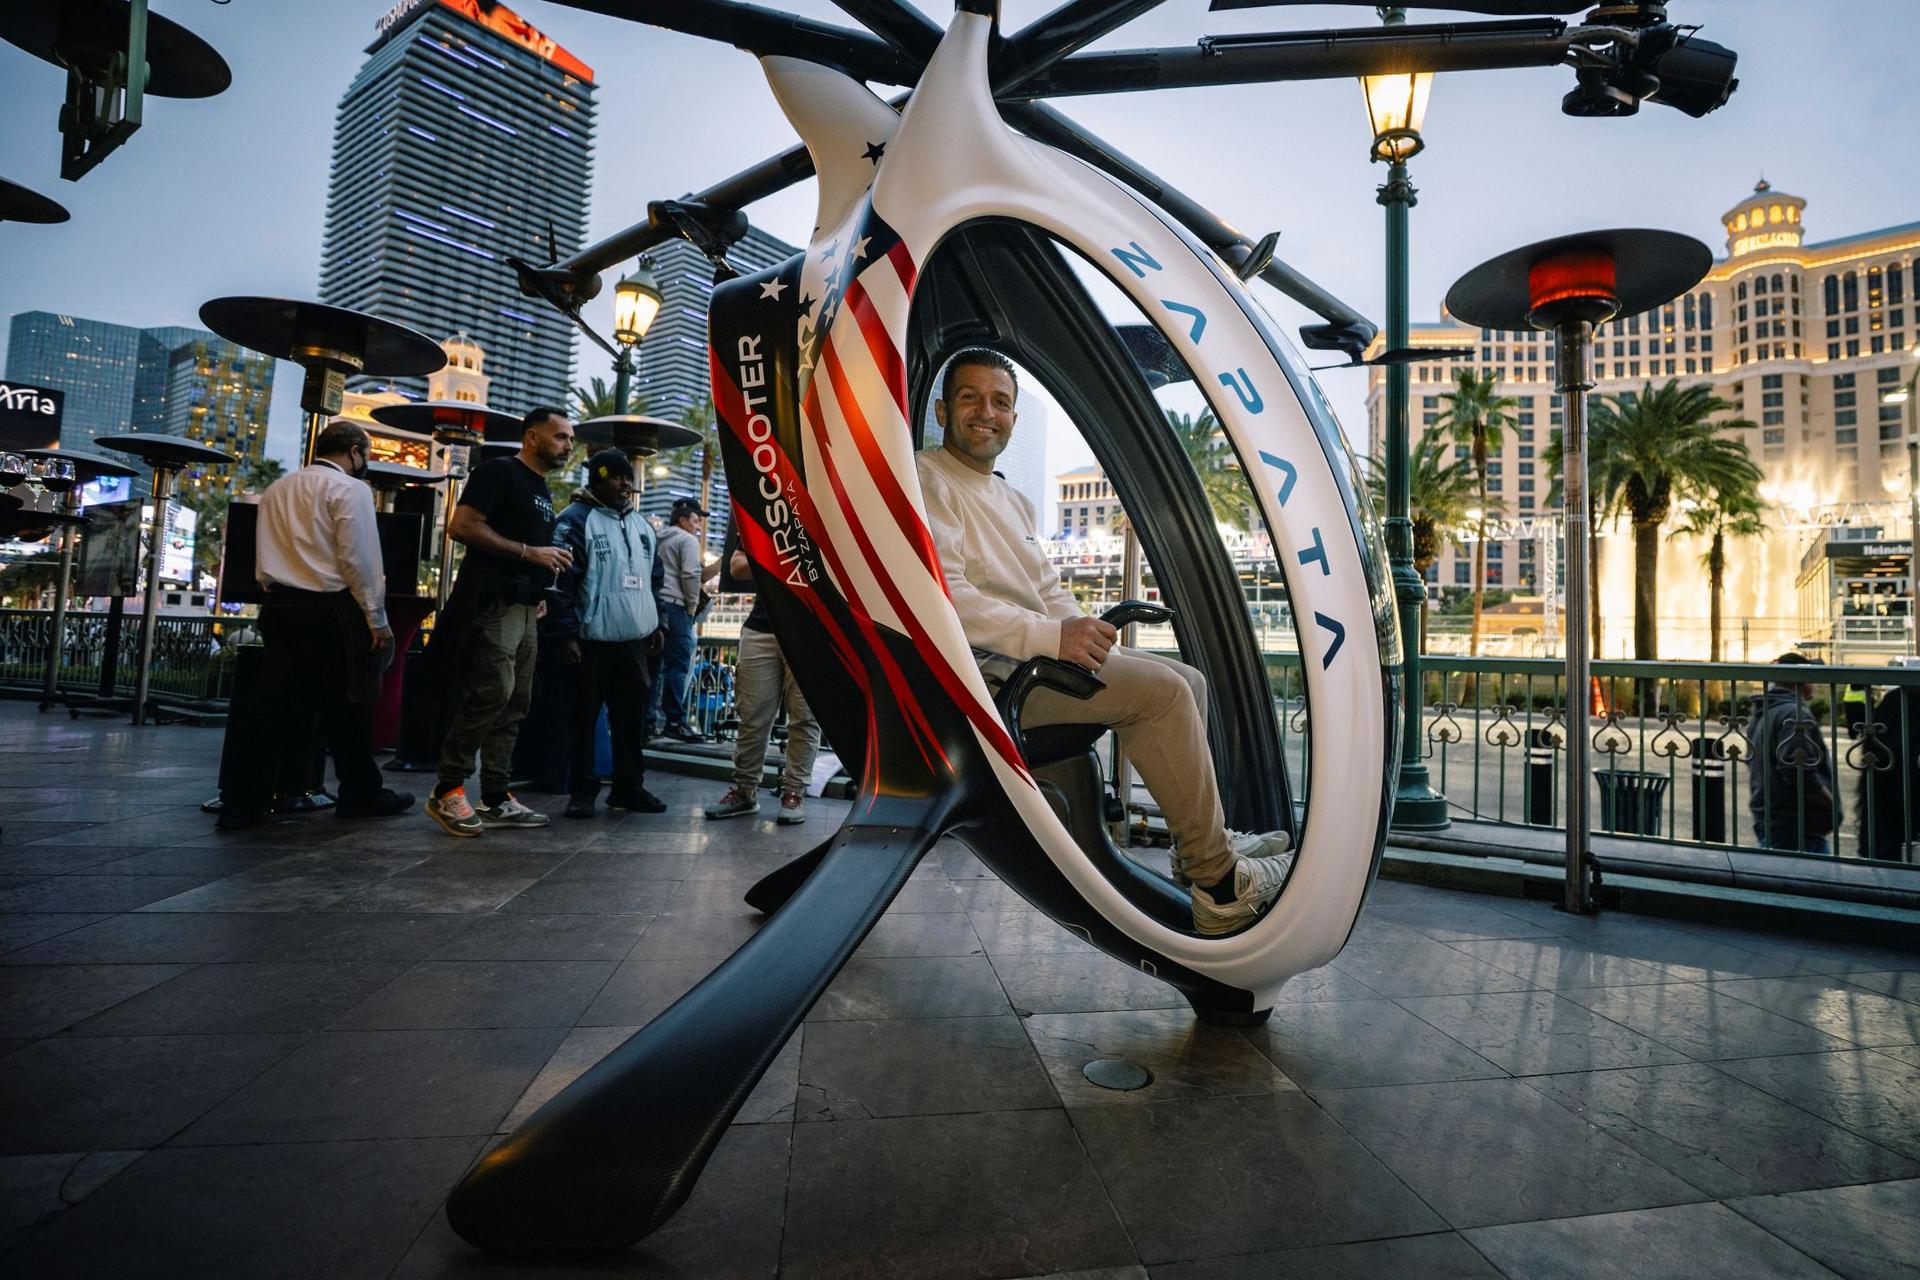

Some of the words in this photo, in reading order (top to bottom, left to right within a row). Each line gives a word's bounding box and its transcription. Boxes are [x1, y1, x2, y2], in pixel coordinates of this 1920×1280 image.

[0, 384, 57, 415] Aria
[738, 334, 809, 588] AIRSCOOTER
[1110, 241, 1347, 671] ZAPATA
[787, 480, 810, 557] ZAPATA
[803, 559, 819, 582] BY
[1863, 544, 1914, 556] Heineke
